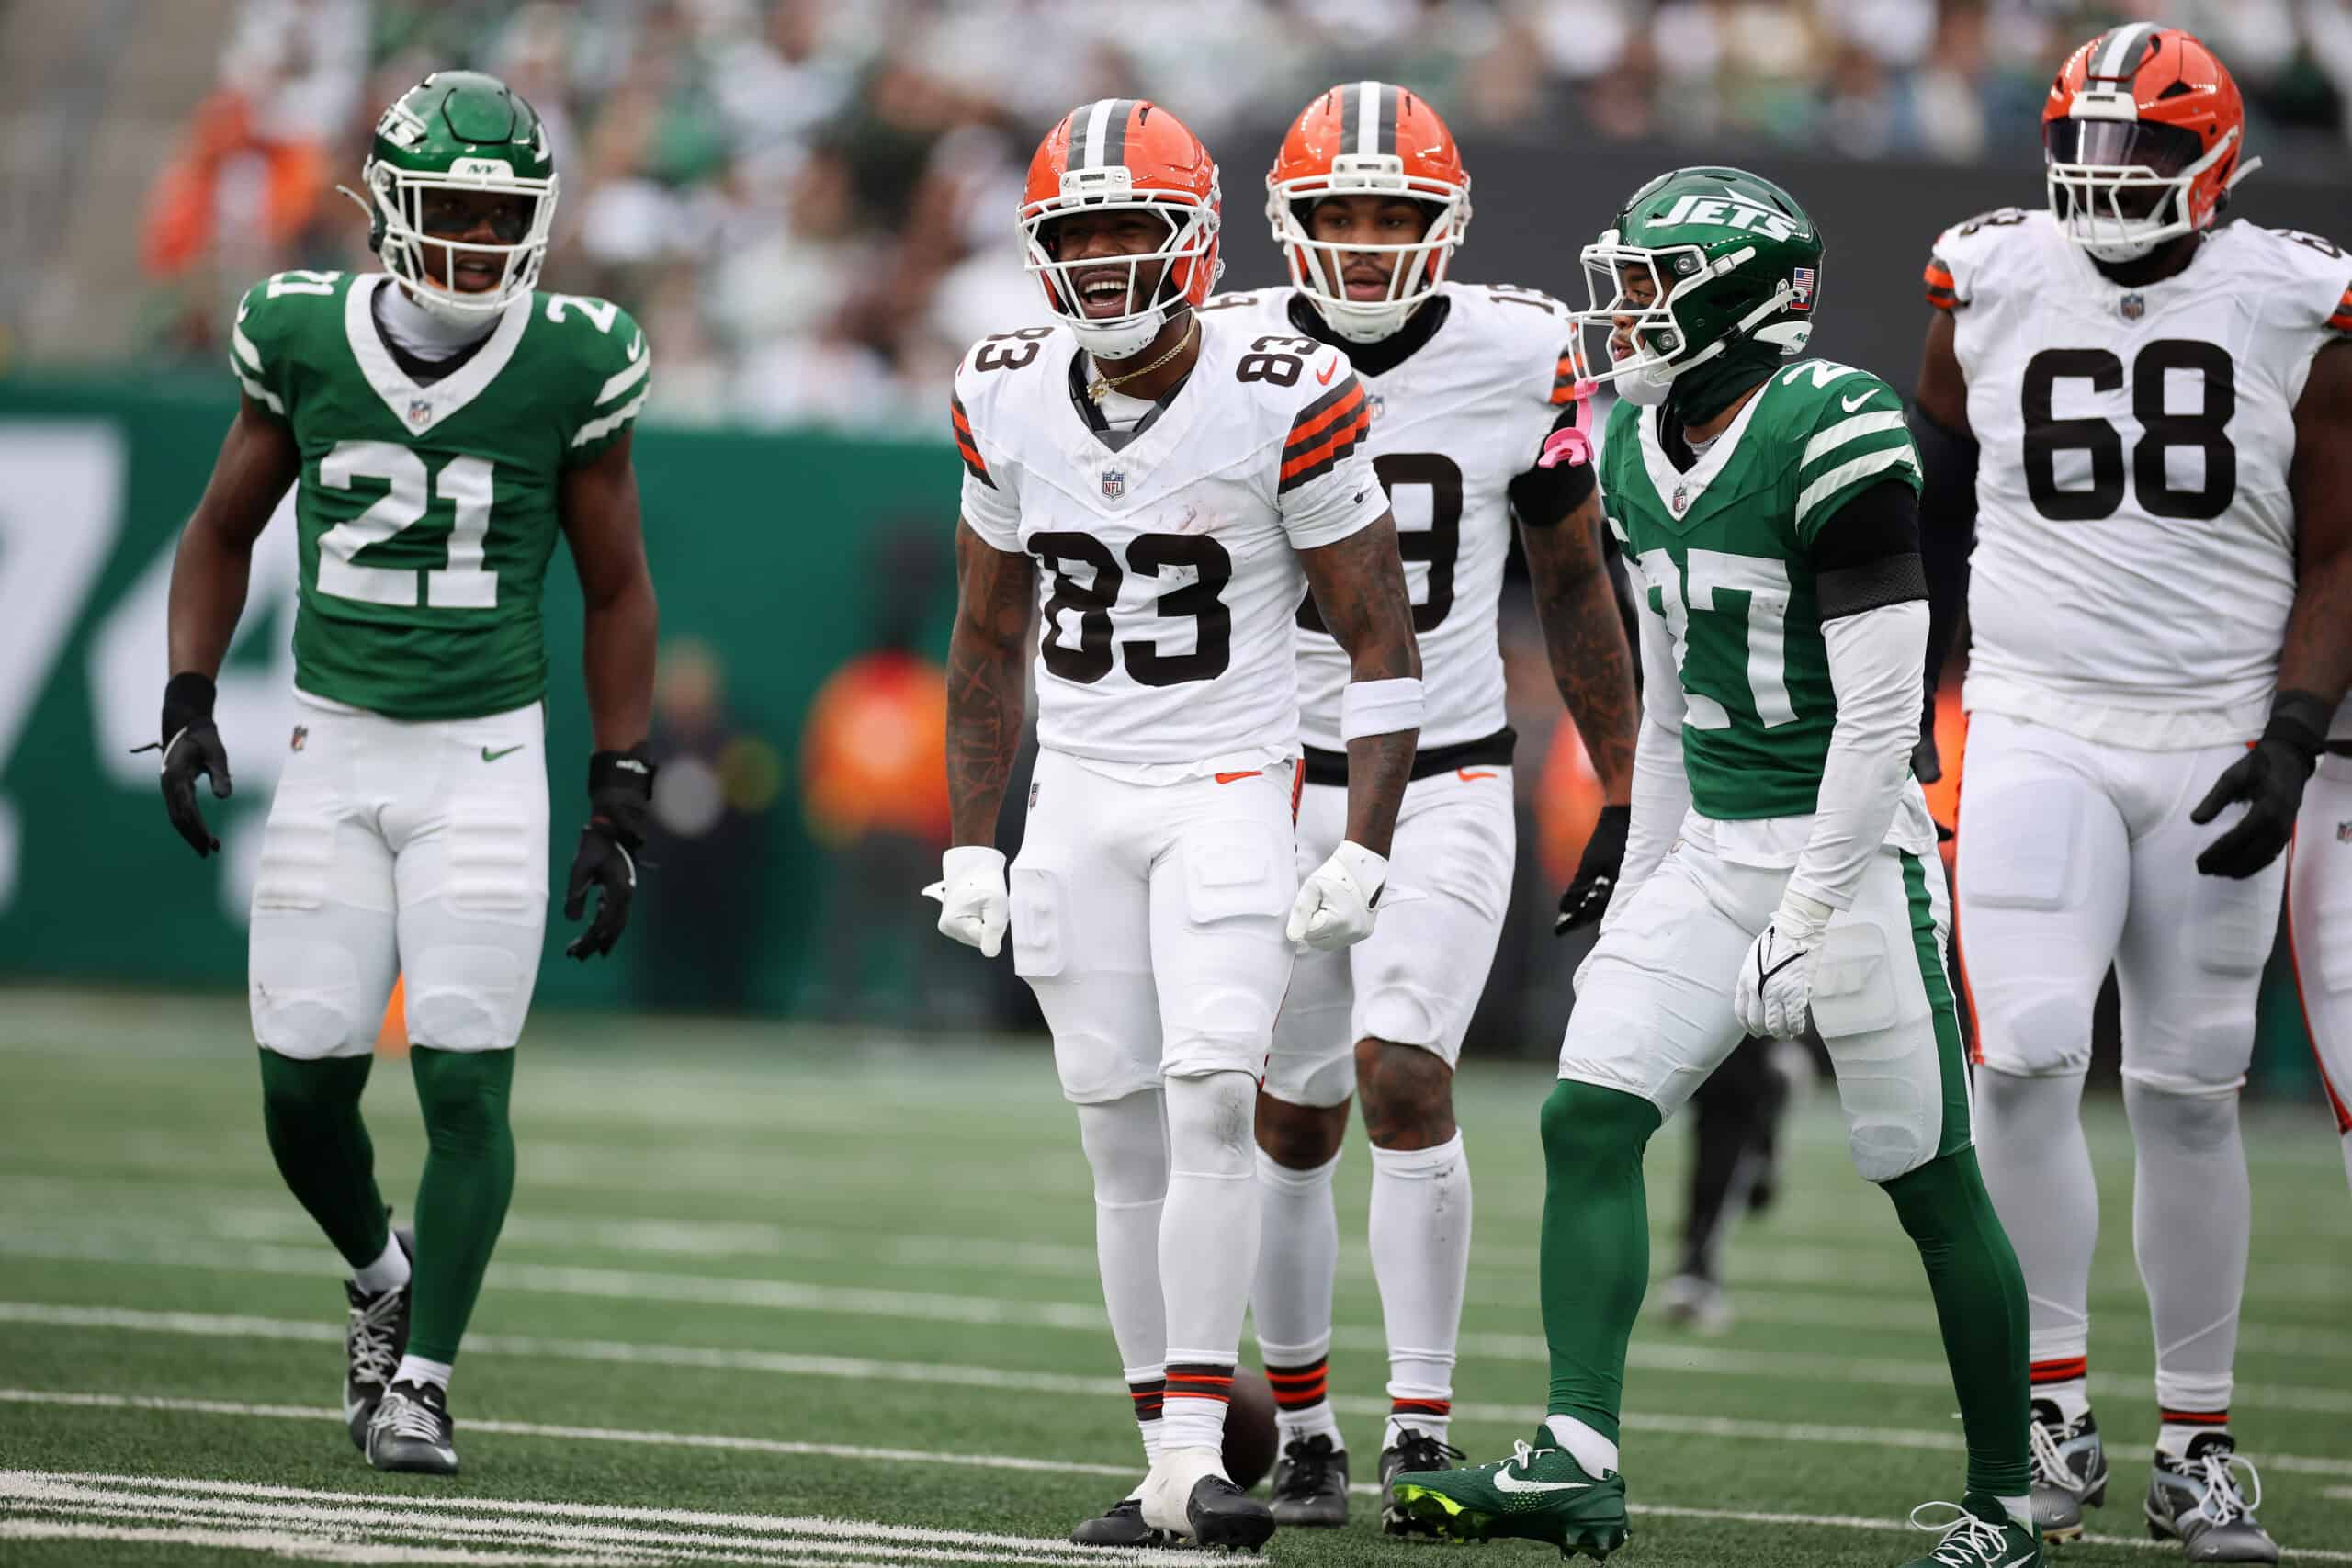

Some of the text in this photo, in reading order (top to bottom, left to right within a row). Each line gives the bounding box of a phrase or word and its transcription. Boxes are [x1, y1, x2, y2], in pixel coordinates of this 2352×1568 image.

[1645, 186, 1798, 243] JETS
[1236, 335, 1322, 388] 83
[2021, 339, 2237, 521] 68
[316, 441, 498, 609] 21
[1027, 531, 1232, 687] 83
[1636, 547, 1799, 730] 27
